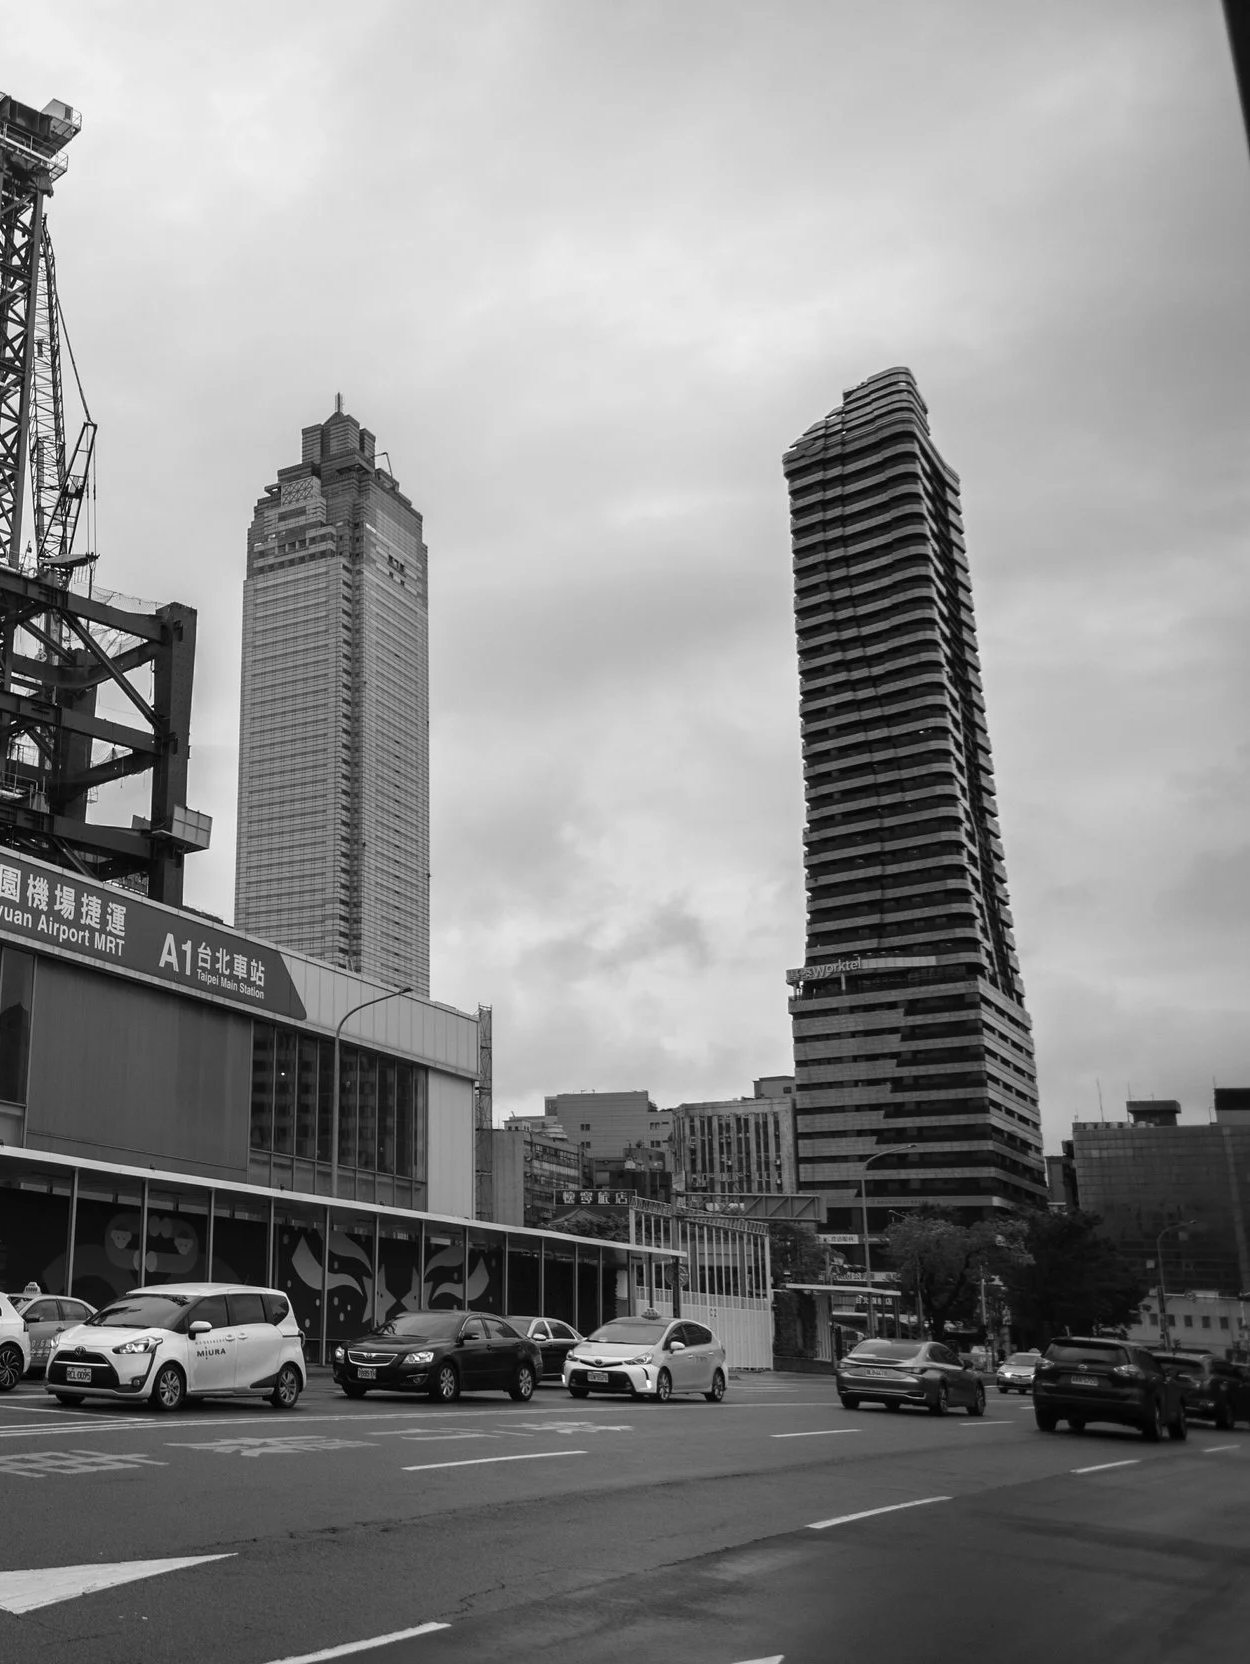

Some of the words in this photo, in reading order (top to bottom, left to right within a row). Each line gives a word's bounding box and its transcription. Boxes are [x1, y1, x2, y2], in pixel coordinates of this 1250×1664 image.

[37, 914, 90, 946] Airport
[94, 932, 125, 957] MRT
[158, 932, 192, 976] A1
[197, 942, 265, 987] 台北車站
[812, 956, 861, 978] Worktel
[196, 968, 219, 985] Taipei
[220, 977, 238, 992] Main
[239, 983, 265, 999] Station
[196, 1347, 226, 1358] MIURA
